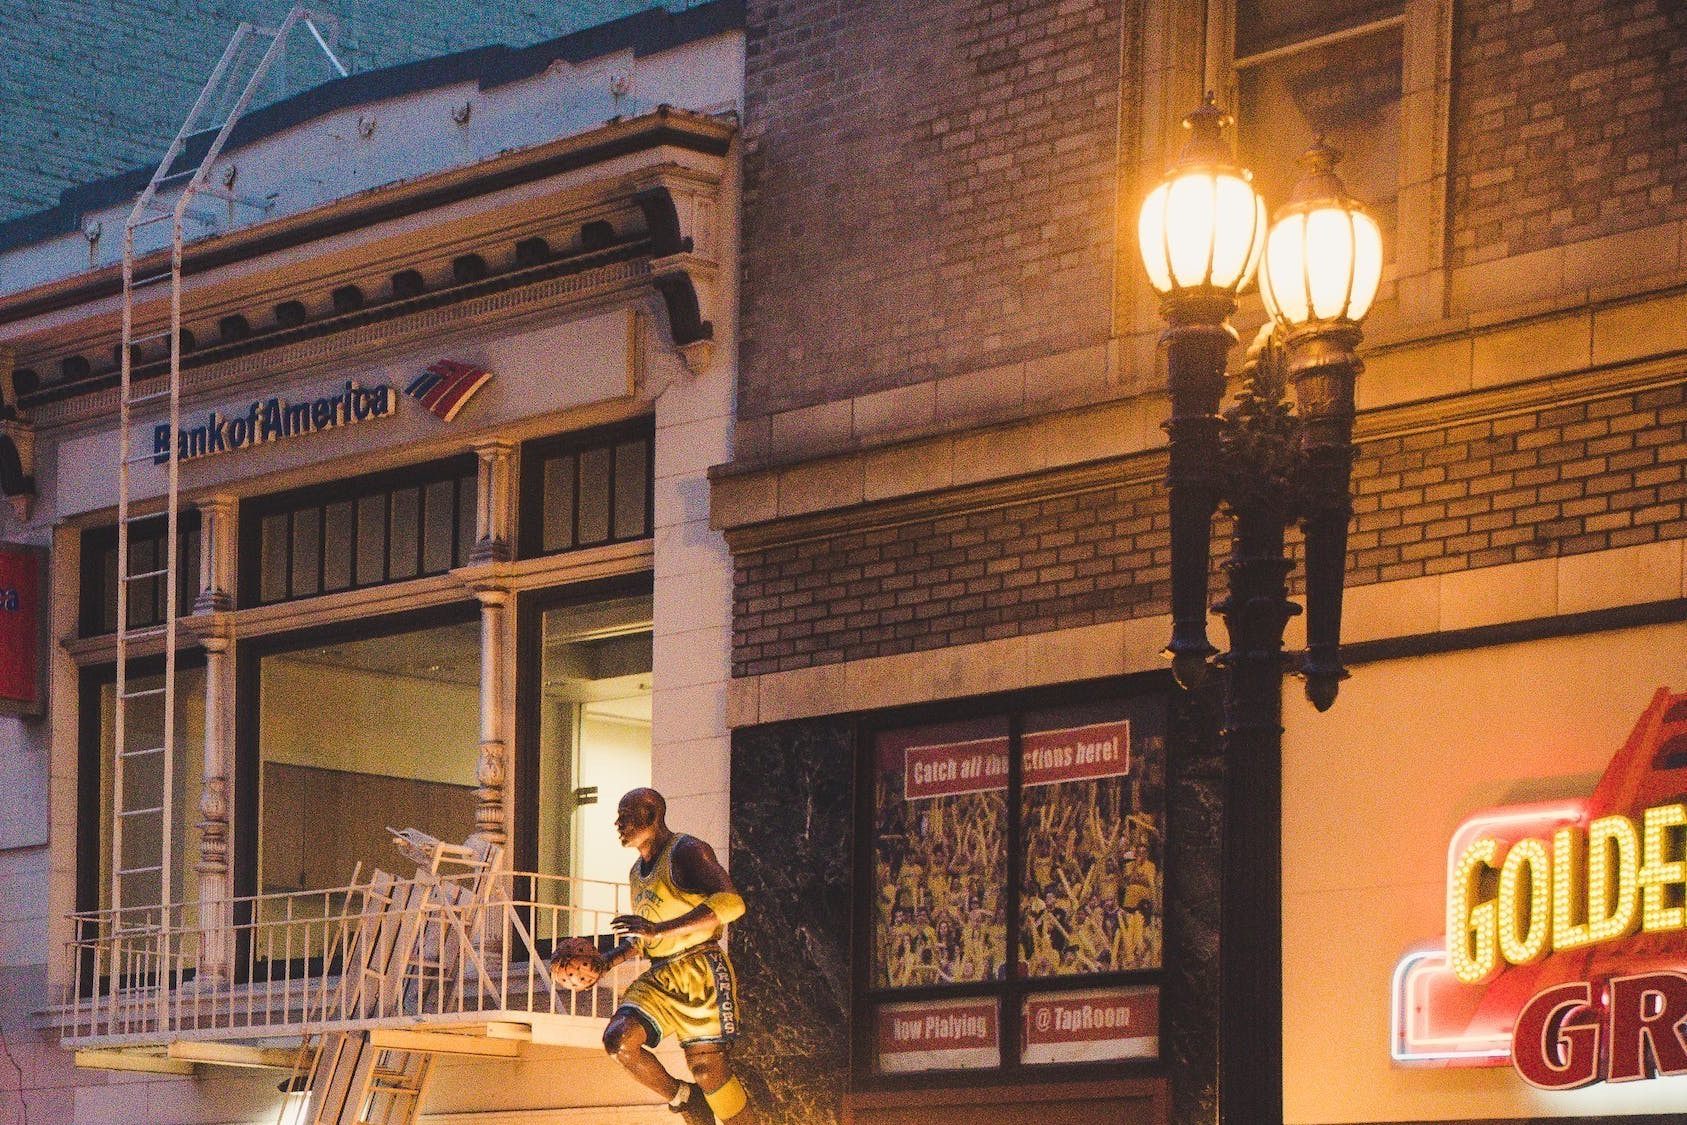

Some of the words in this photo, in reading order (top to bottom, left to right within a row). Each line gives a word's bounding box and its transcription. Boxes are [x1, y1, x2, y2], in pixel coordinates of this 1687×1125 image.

[153, 411, 230, 465] Bank
[229, 400, 262, 449] of
[262, 380, 397, 443] America
[914, 758, 957, 784] Catch
[960, 755, 983, 778] all
[1021, 744, 1072, 771] ctions
